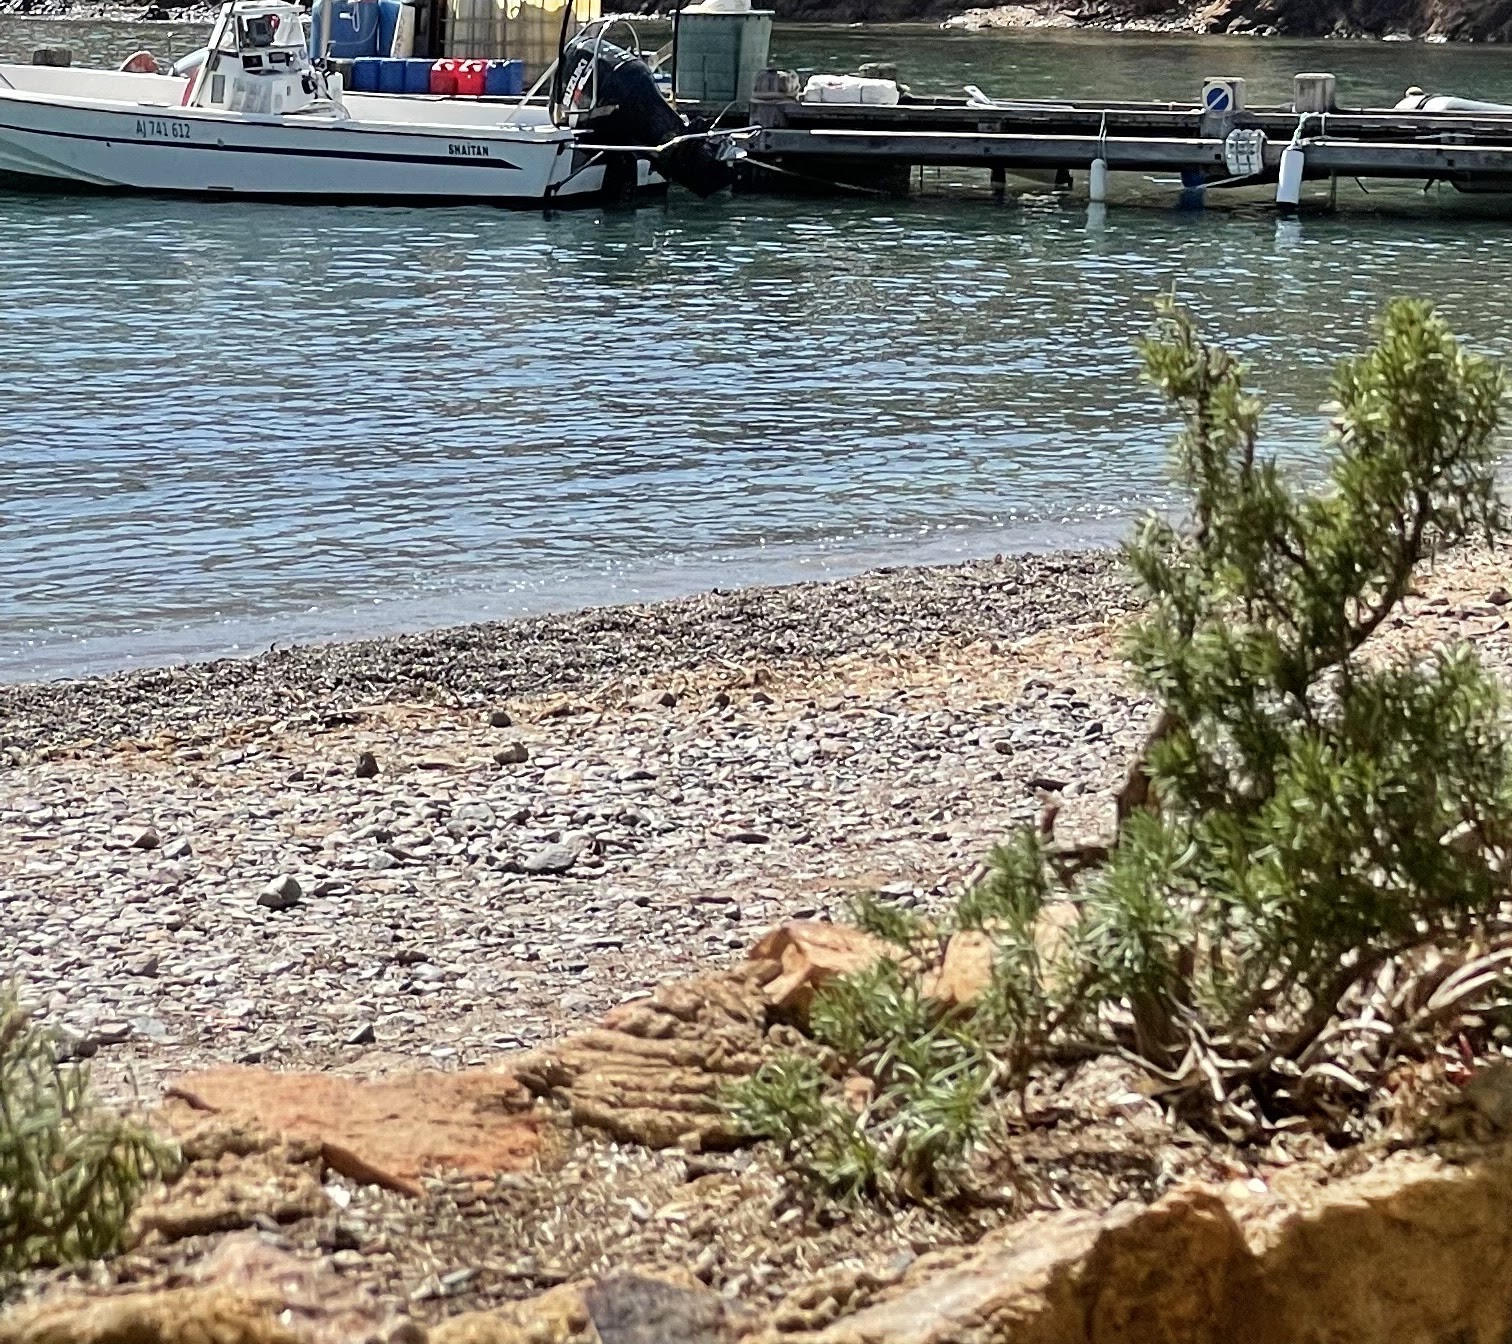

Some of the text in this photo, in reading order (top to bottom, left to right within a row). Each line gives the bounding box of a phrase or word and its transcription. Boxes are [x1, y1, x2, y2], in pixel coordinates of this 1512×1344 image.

[562, 58, 588, 107] SUZUKI
[136, 119, 191, 139] AJ 741 612
